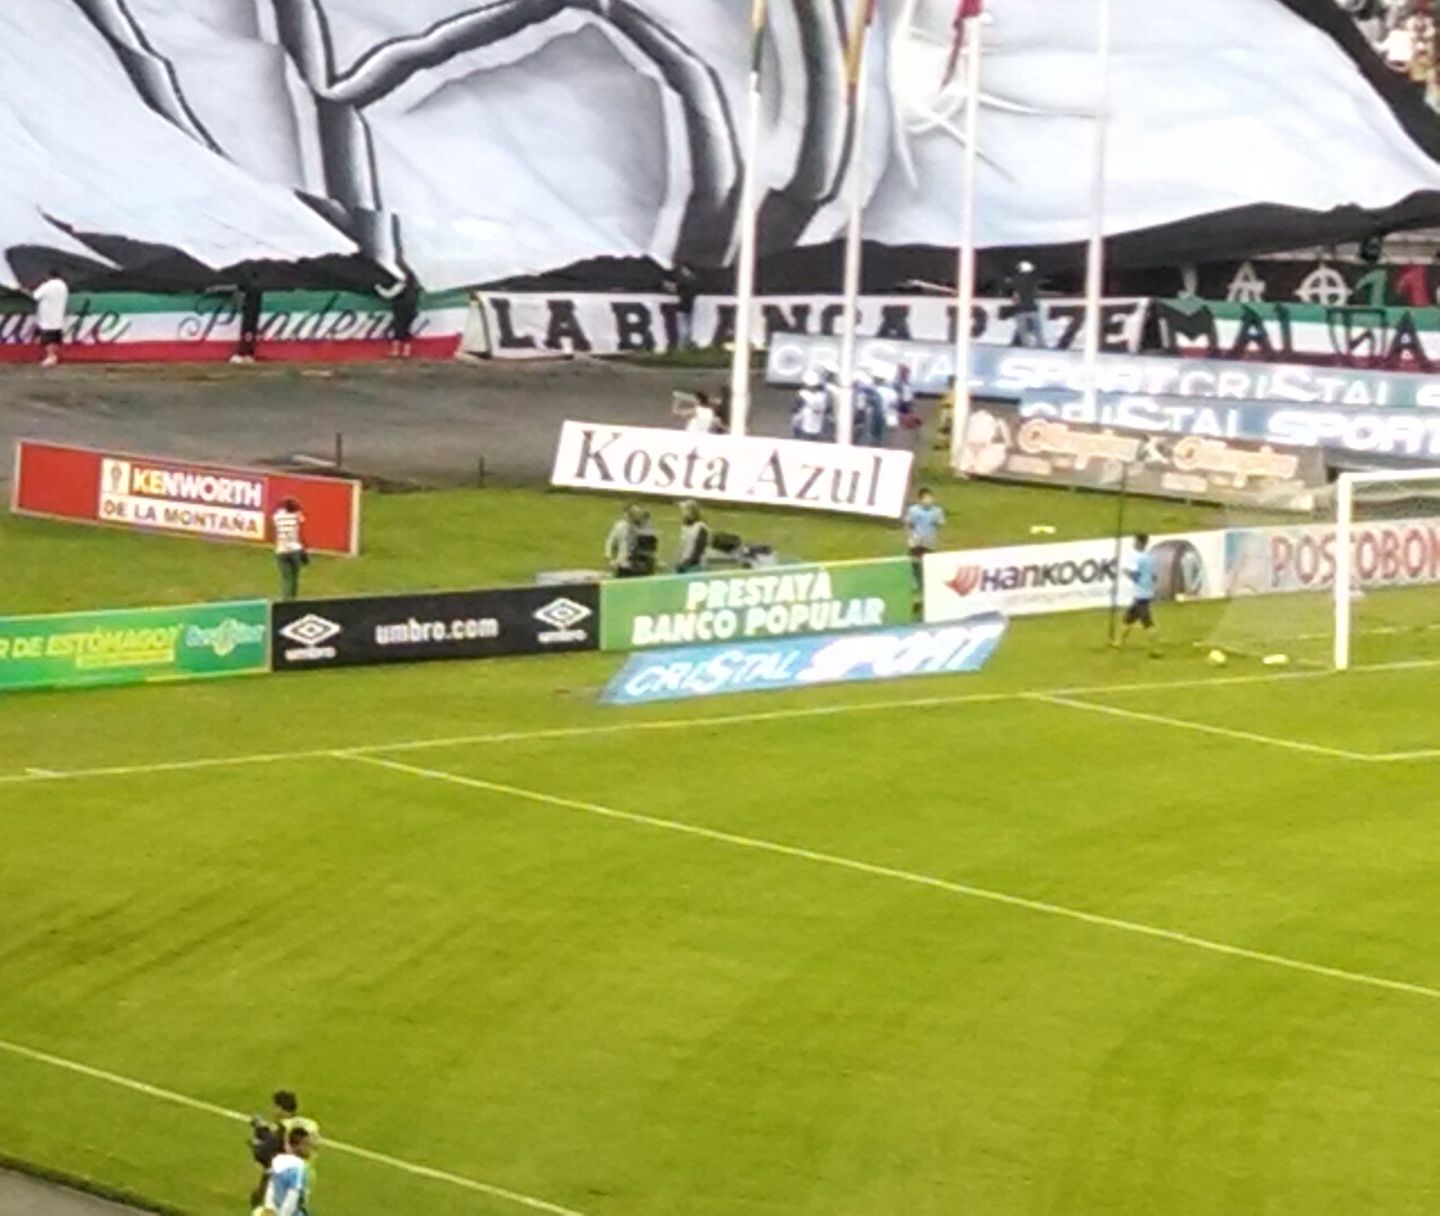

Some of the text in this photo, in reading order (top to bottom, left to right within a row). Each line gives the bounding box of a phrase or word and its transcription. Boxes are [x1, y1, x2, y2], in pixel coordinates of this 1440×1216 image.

[490, 298, 592, 351] LA
[133, 468, 262, 507] KENWORTH
[575, 430, 882, 508] Kosta Azul
[104, 498, 259, 535] DE LA MONTAÑA
[1271, 527, 1440, 588] POSOBO
[375, 617, 499, 645] umbro.com
[631, 598, 886, 645] BANCO POPULAR
[12, 636, 46, 659] DE
[624, 622, 1008, 696] CRISTAL SPORT
